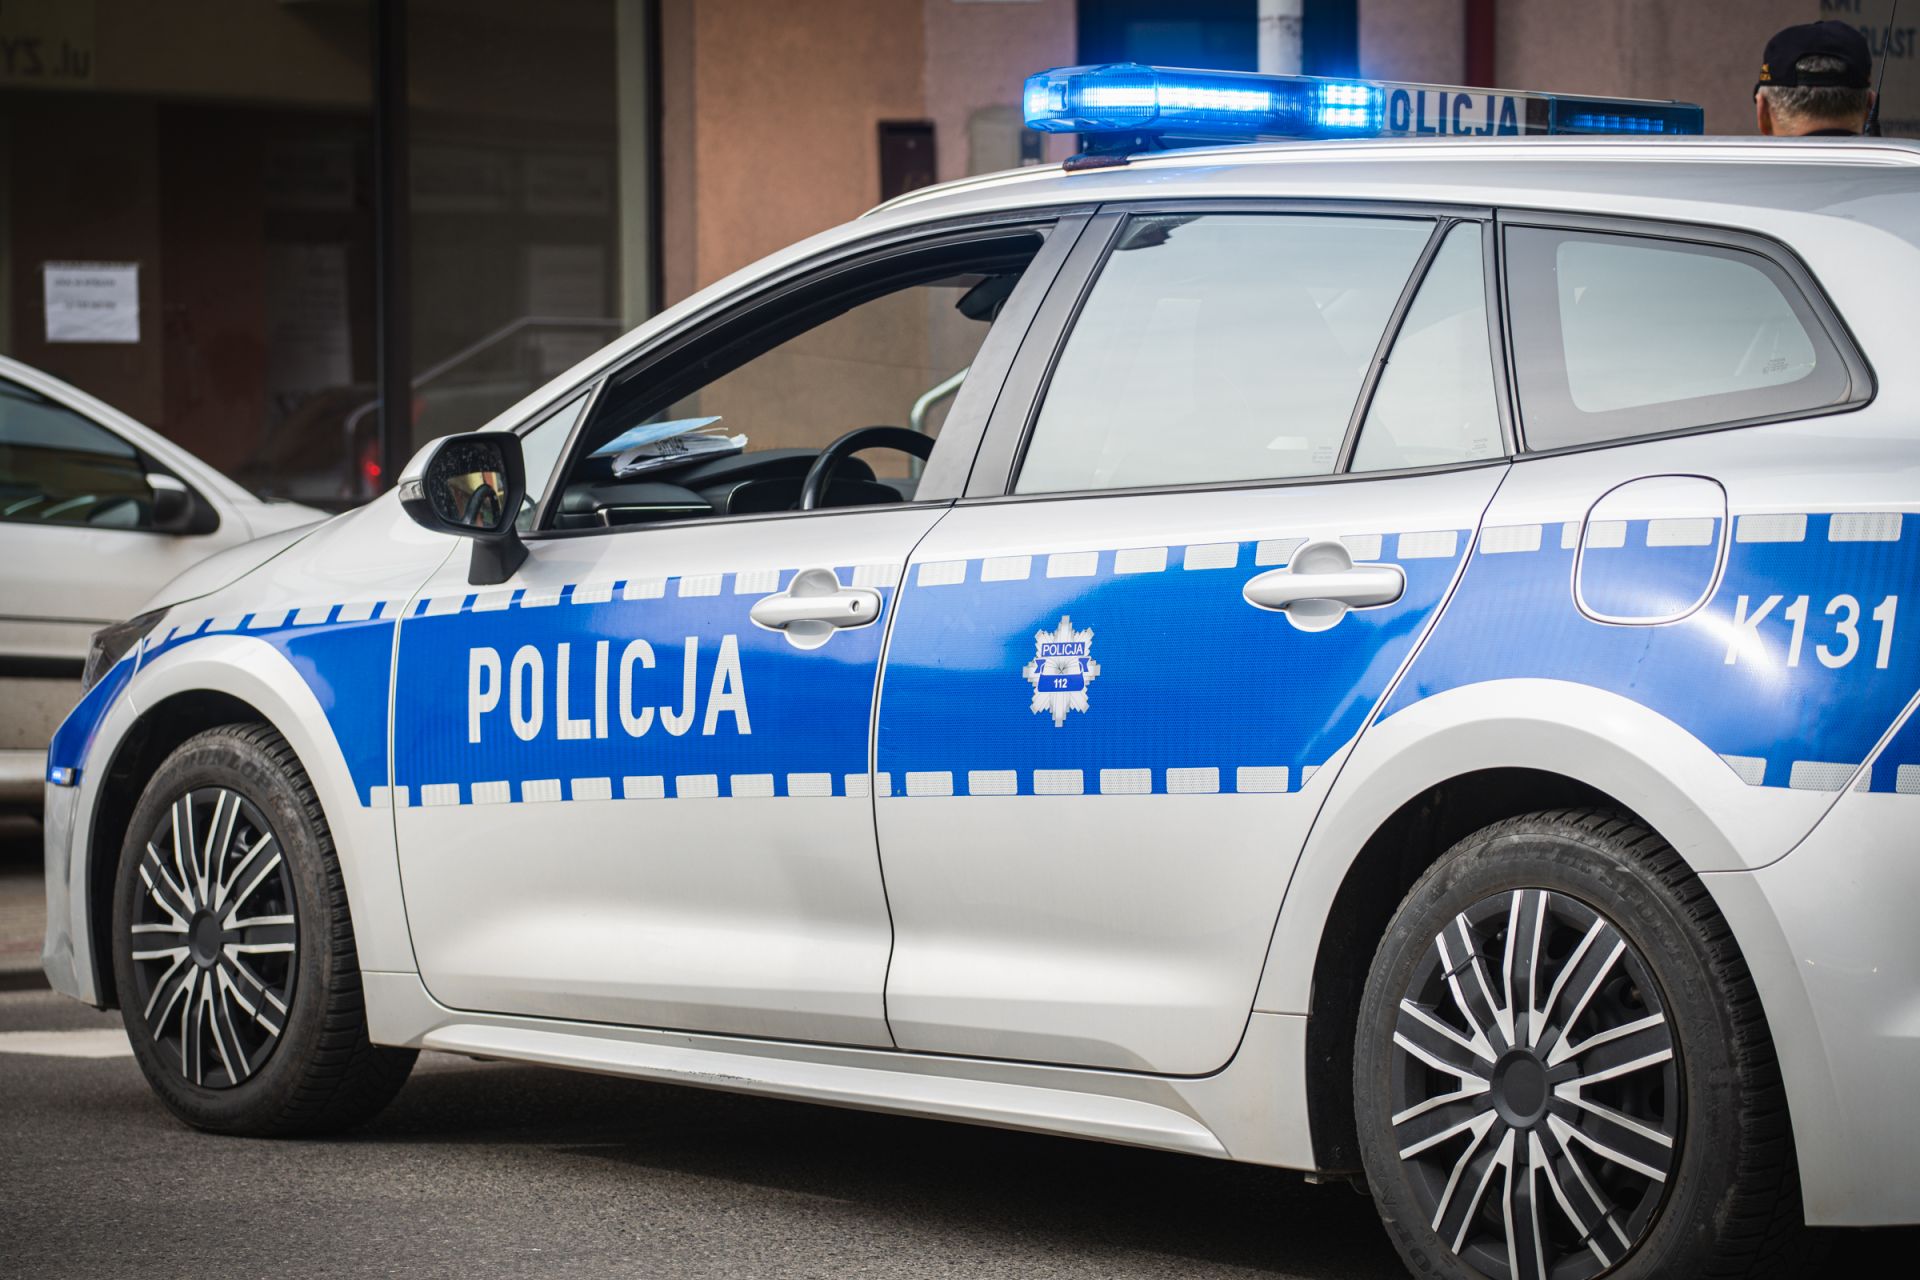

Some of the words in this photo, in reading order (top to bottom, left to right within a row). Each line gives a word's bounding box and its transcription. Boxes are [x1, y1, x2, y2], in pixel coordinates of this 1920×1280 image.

[1859, 24, 1916, 56] LAST
[1389, 88, 1519, 137] OLICJA
[1042, 643, 1084, 656] POLICJA
[1724, 593, 1898, 669] K131
[468, 634, 752, 743] POLICJA
[1053, 678, 1068, 689] 112
